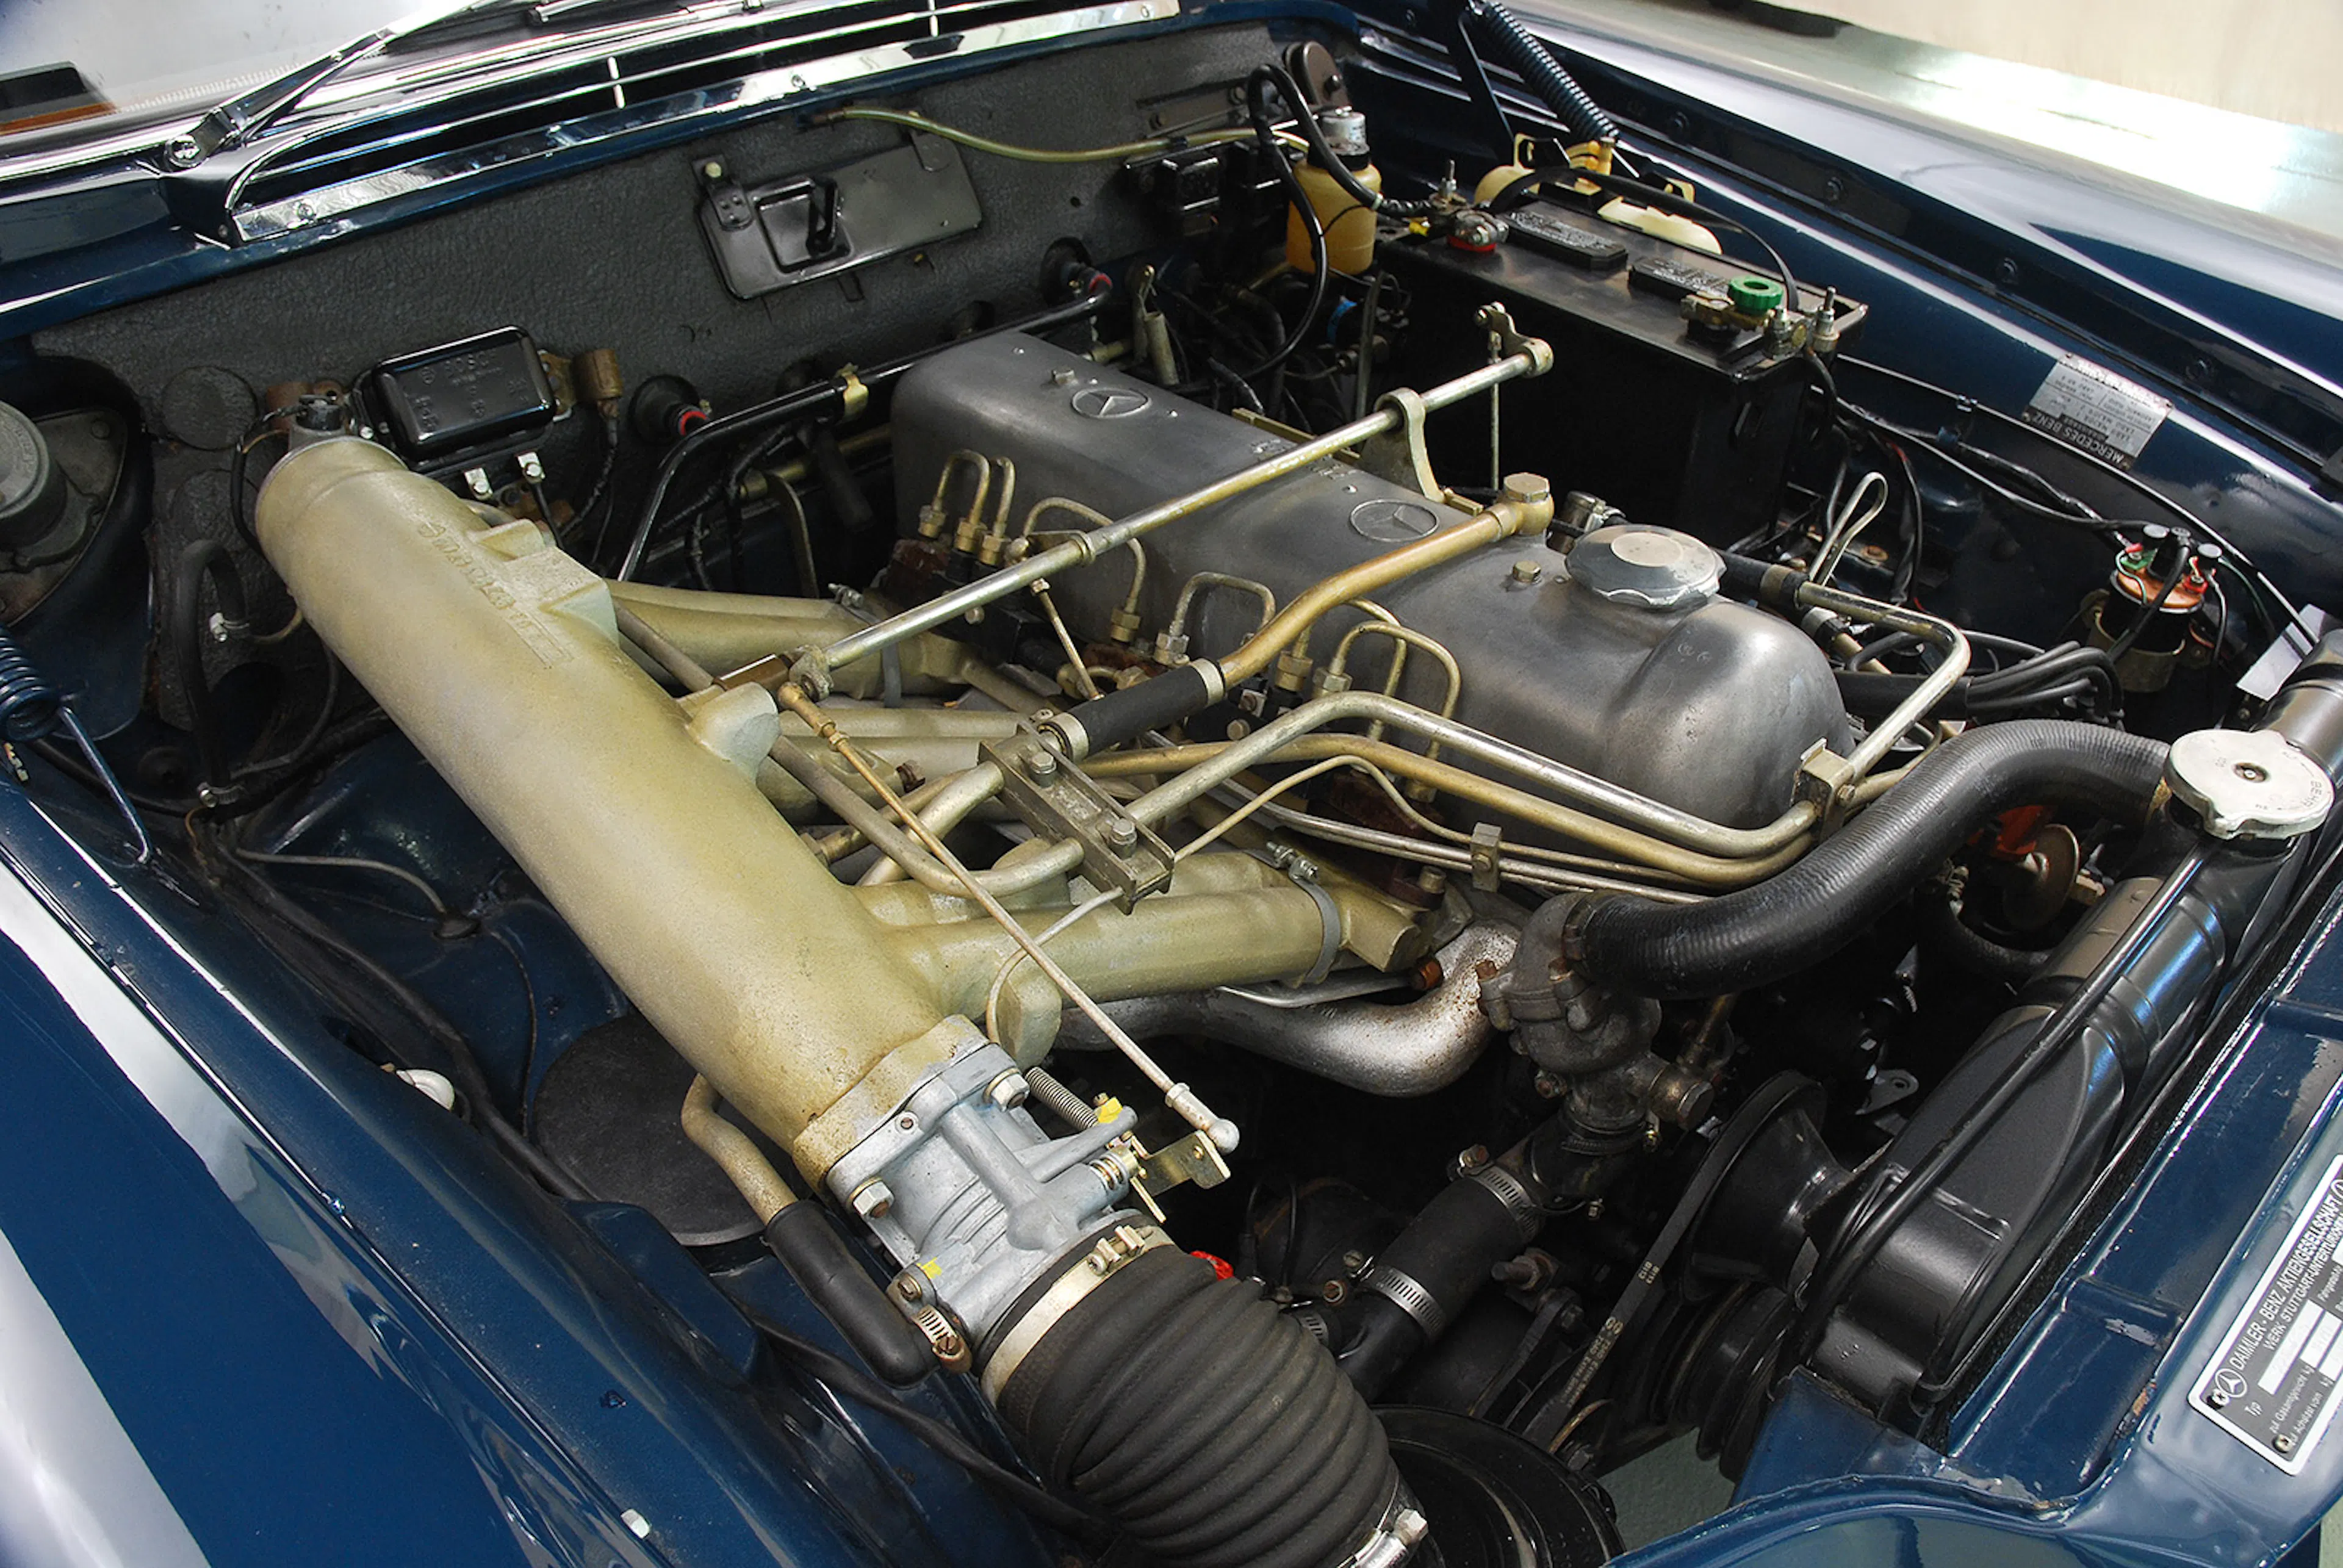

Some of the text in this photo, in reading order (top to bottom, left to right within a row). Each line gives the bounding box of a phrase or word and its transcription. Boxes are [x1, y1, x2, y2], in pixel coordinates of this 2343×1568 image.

[2032, 412, 2063, 433] BENZ
[2063, 426, 2125, 464] MERCEDES
[2229, 1322, 2267, 1370] DAIMLER
[2259, 1289, 2286, 1322] BENZ
[2276, 1194, 2343, 1293] AKTIENGESELLSCHAFT
[2263, 1322, 2287, 1351] WERK
[2244, 1401, 2264, 1417] Typ
